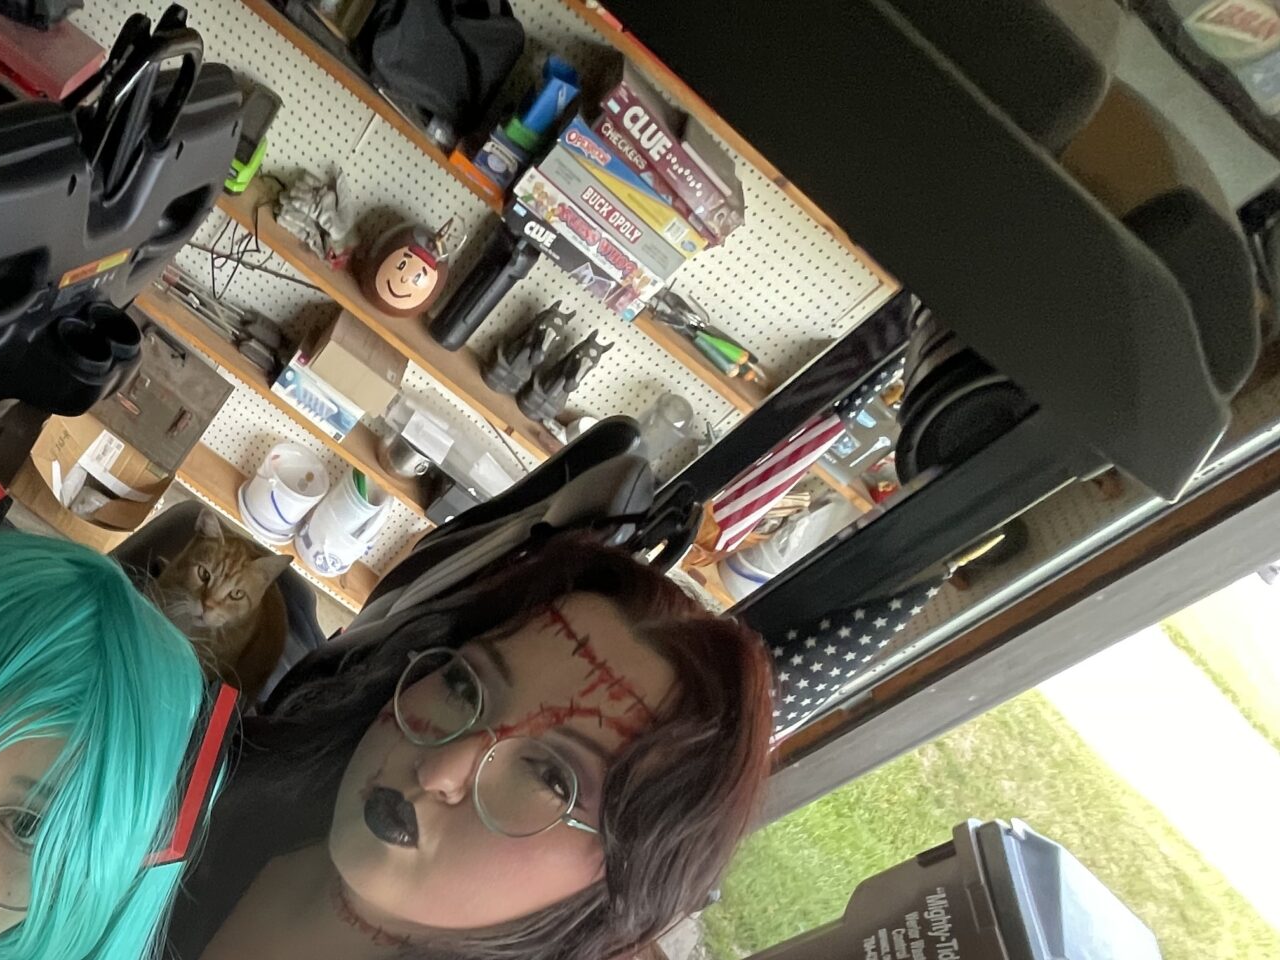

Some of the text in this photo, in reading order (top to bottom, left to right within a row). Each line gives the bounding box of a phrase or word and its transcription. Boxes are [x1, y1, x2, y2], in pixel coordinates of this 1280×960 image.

[600, 121, 647, 170] CHECKERS
[623, 105, 671, 162] CLUE
[523, 220, 557, 248] CLUE
[581, 186, 612, 219] BUCK
[608, 212, 642, 243] OPOLY
